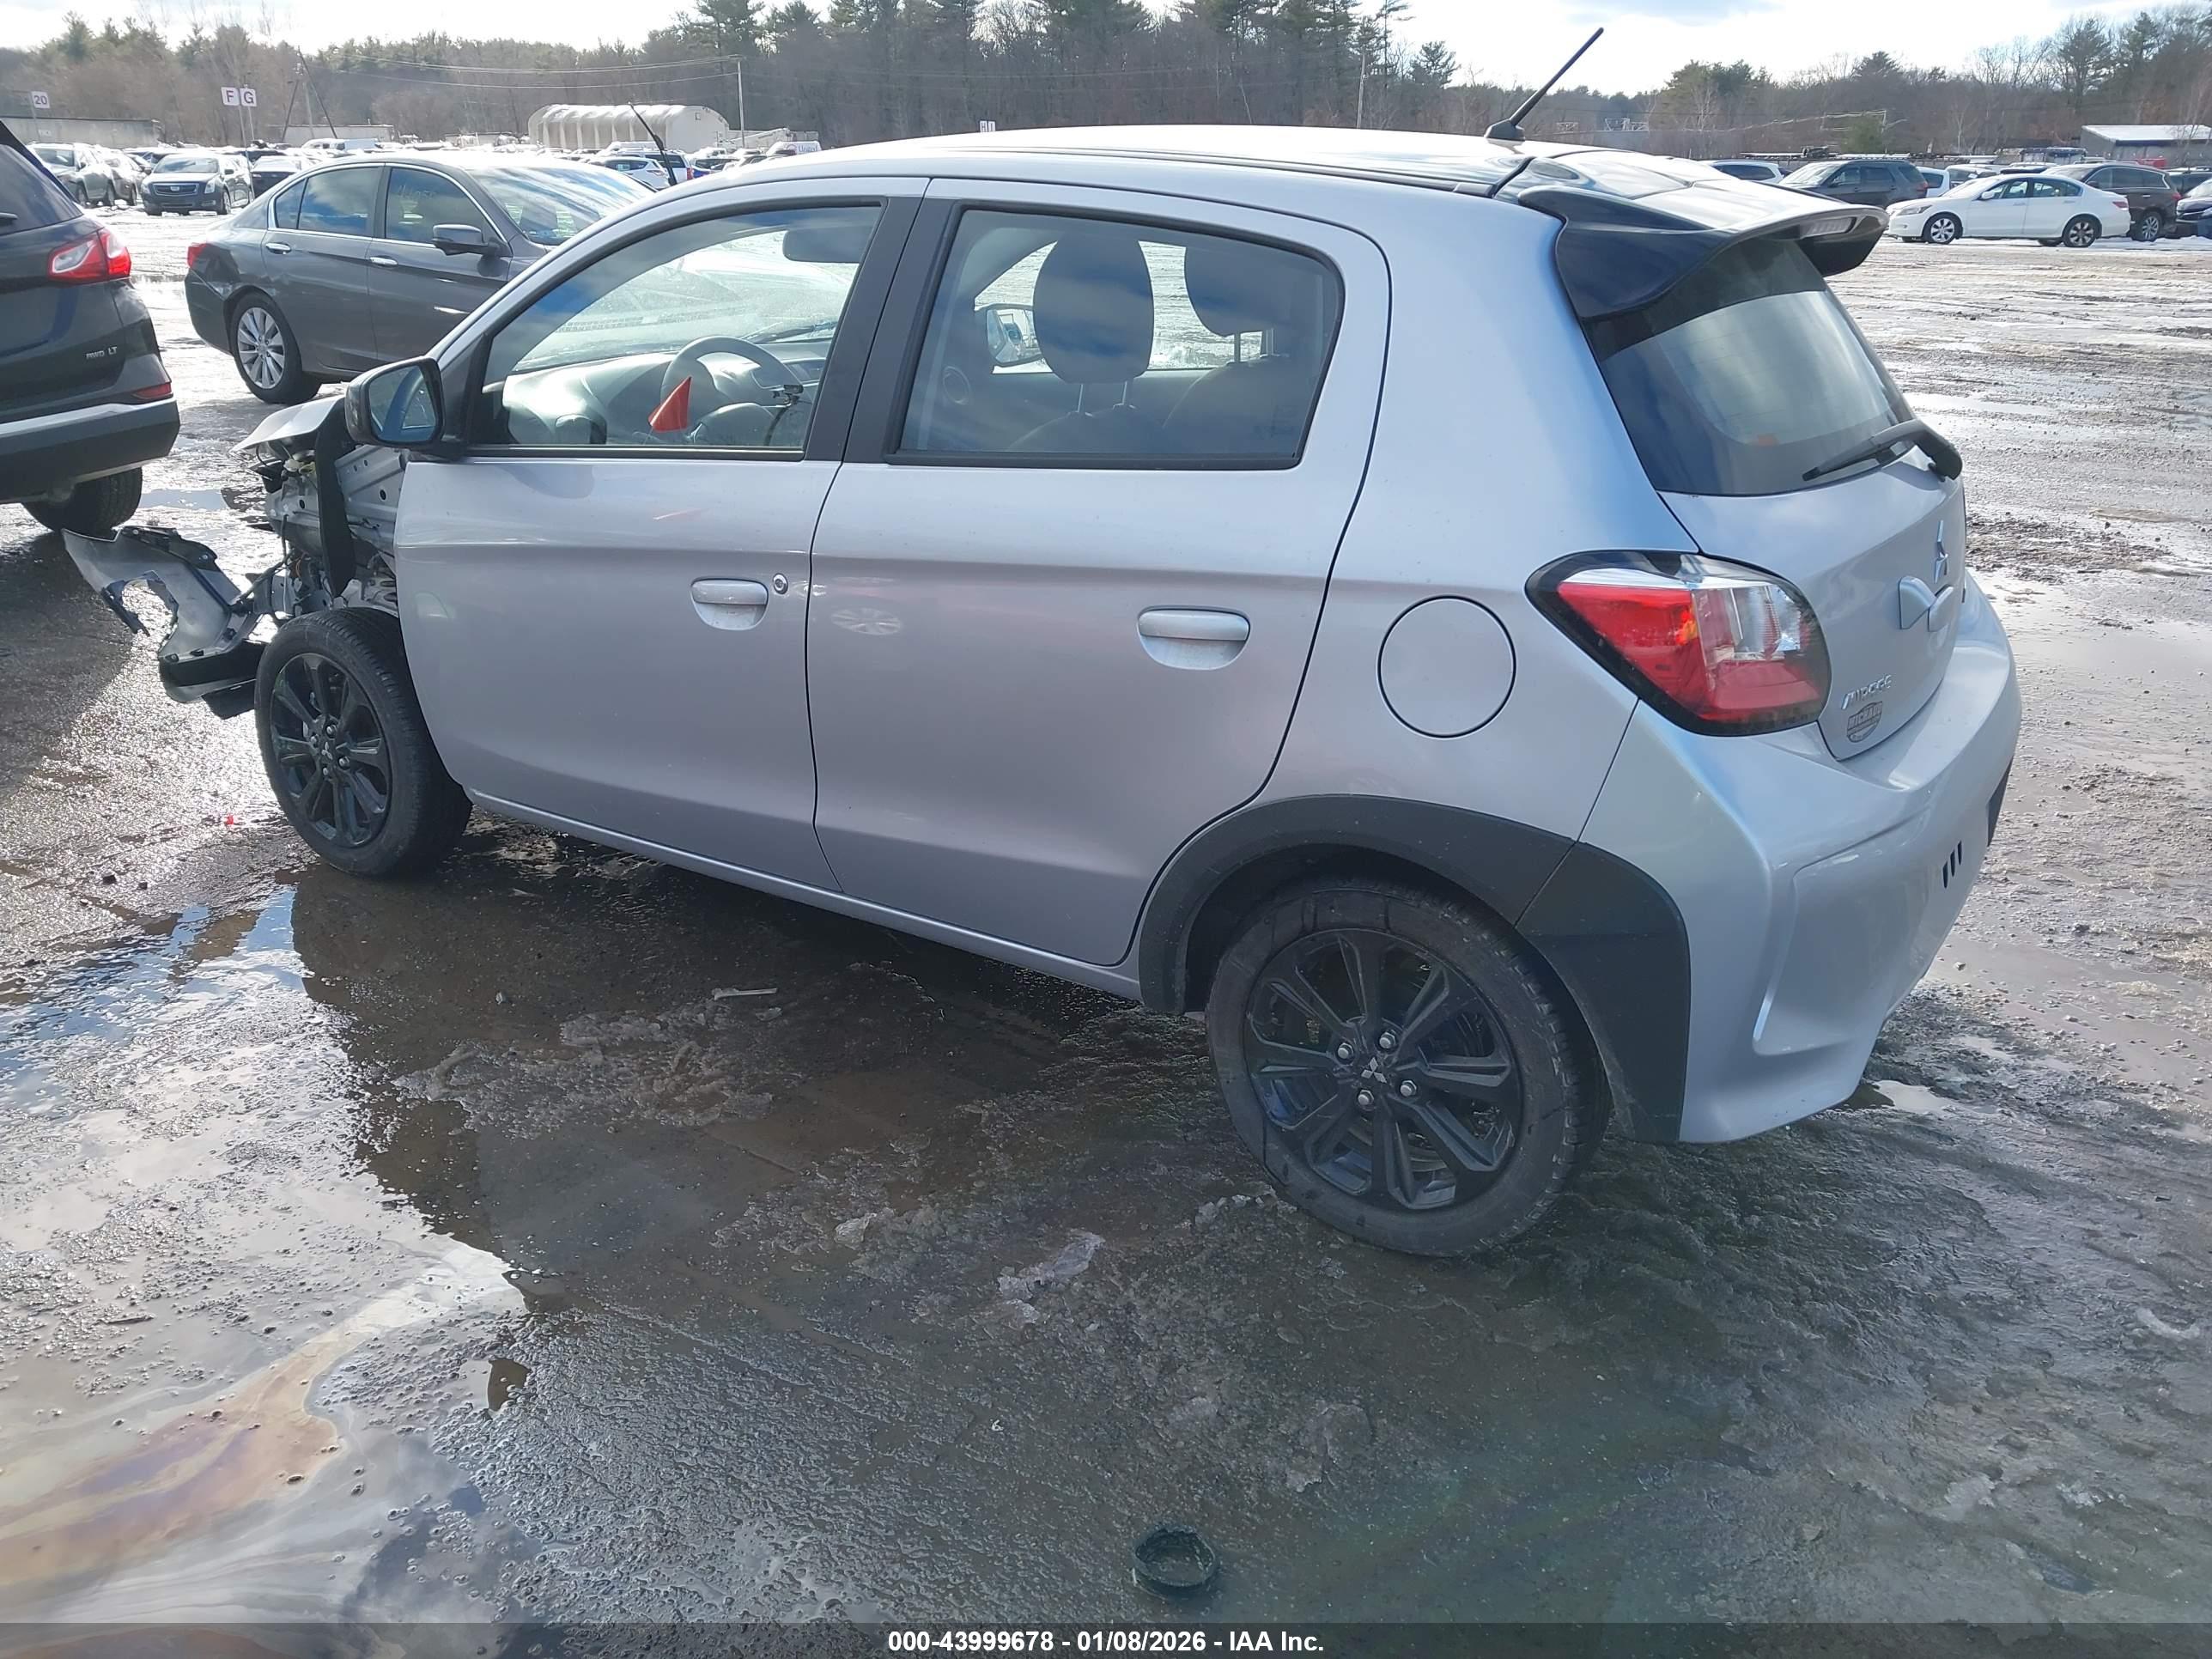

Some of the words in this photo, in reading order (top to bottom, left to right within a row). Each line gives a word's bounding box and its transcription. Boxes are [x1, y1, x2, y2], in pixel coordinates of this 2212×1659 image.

[33, 94, 48, 105] 20
[226, 89, 234, 103] F
[243, 91, 254, 104] G
[108, 346, 118, 356] LT
